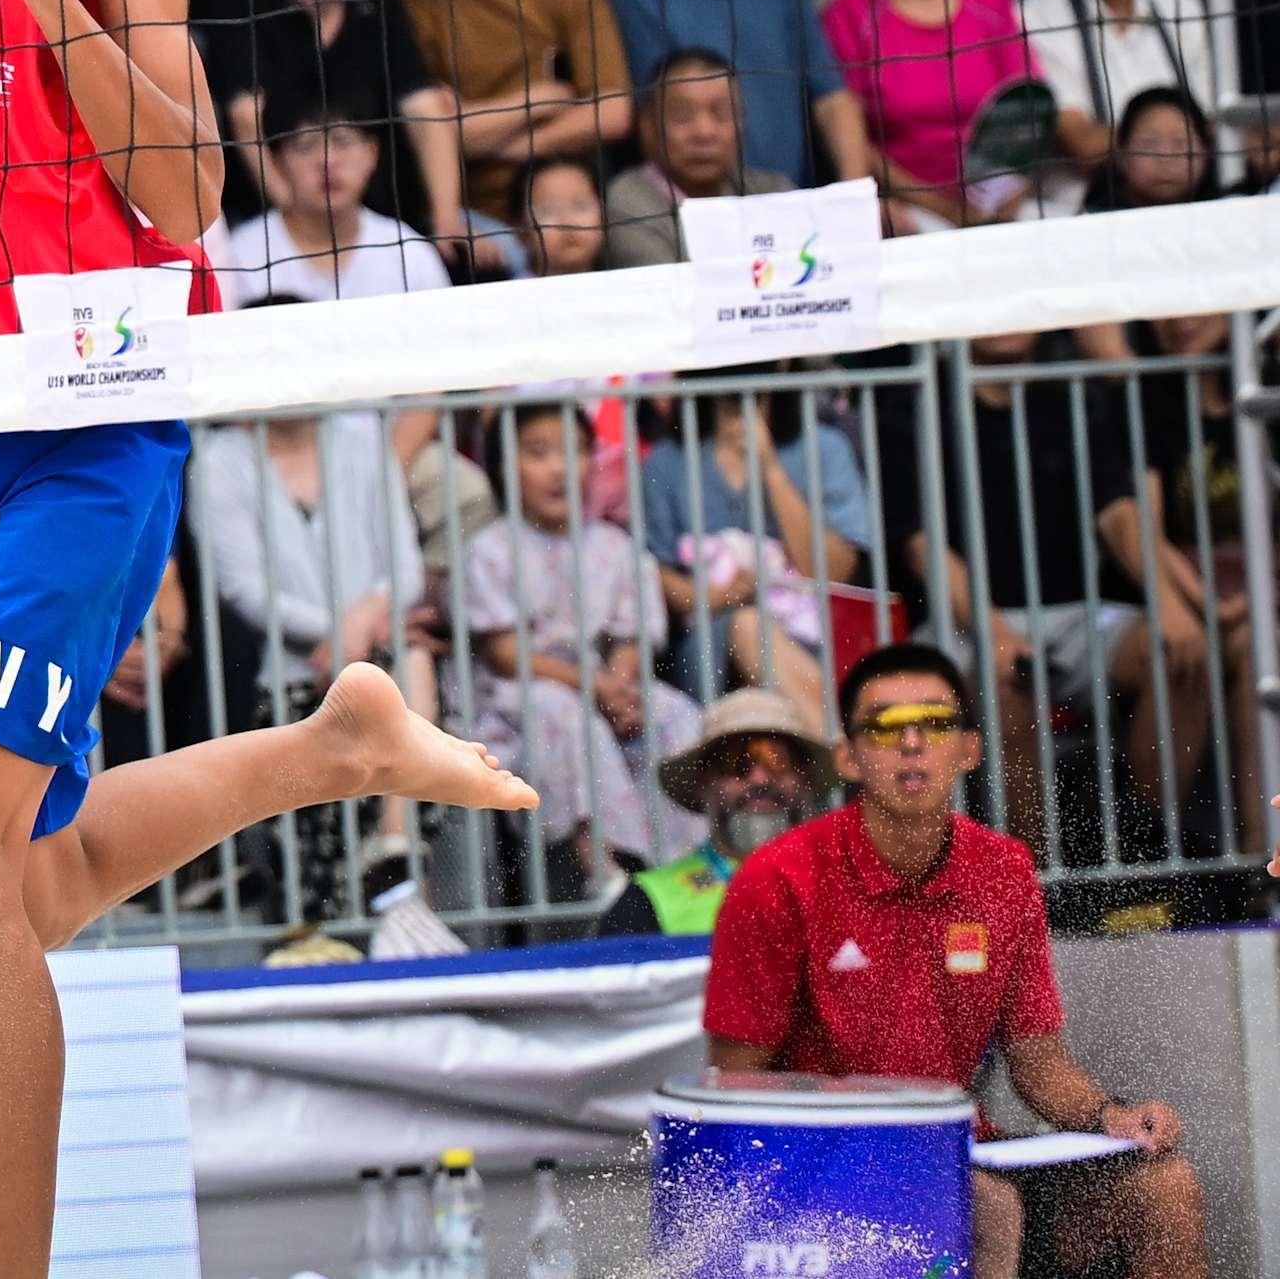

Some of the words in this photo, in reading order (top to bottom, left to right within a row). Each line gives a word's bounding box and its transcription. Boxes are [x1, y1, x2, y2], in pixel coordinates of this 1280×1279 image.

[73, 307, 93, 320] FIVB
[67, 372, 96, 388] WORLD
[98, 366, 167, 386] CHAMPIONSHIPS
[37, 661, 73, 734] Y
[741, 1240, 829, 1277] FIVB
